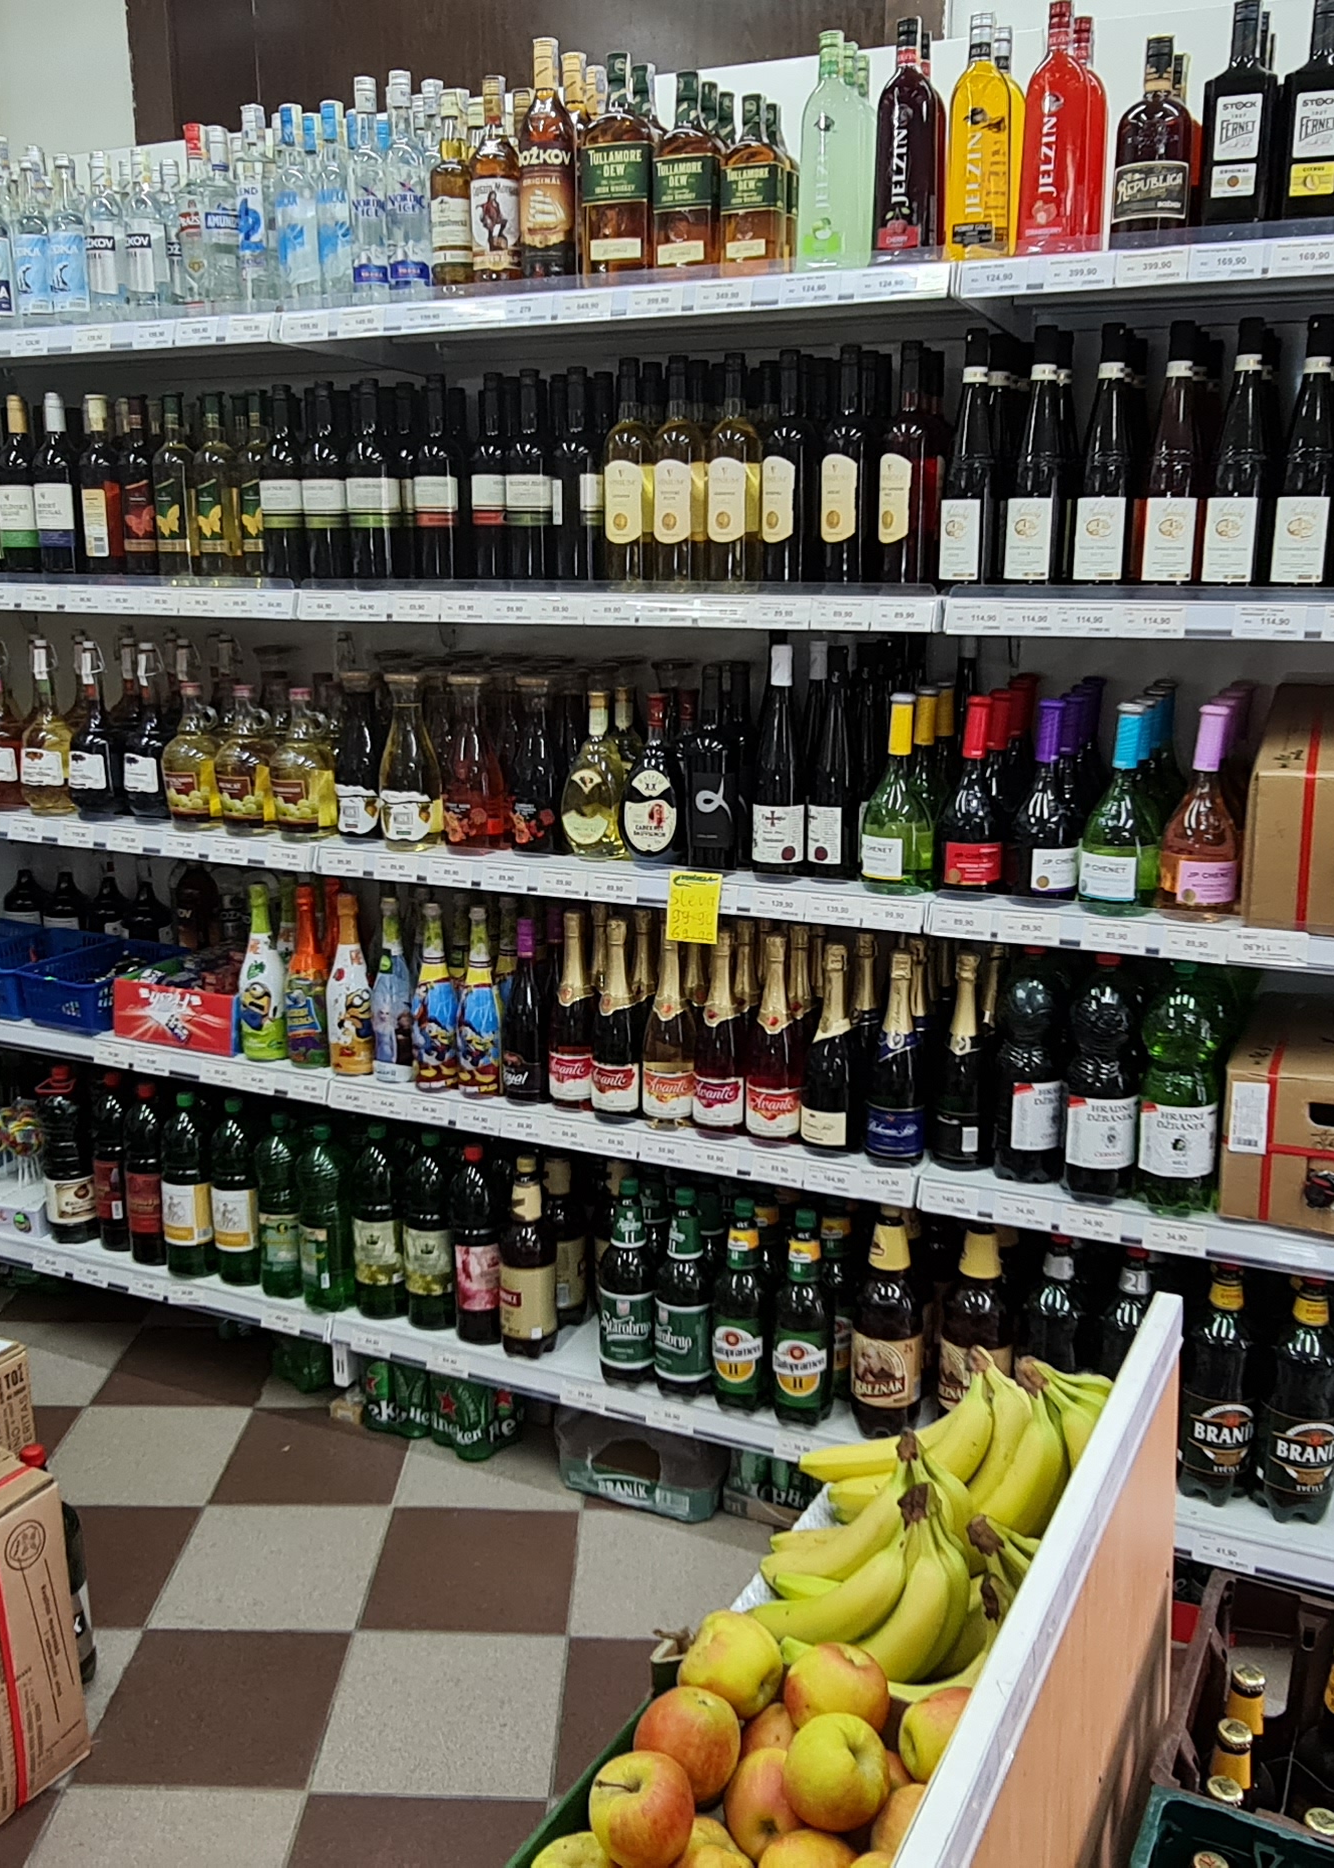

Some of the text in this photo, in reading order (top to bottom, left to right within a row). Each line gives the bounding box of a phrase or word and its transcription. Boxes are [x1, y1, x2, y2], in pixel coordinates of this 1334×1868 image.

[1222, 100, 1258, 110] STOCK
[1220, 119, 1255, 145] FERNET
[587, 149, 642, 165] TULLAMORE
[1038, 116, 1058, 197] JELZIN
[656, 160, 703, 178] TULLAMORE
[890, 127, 910, 206] JELZIN
[965, 131, 984, 214] JELZIN
[1116, 171, 1184, 203] REPUBLICA
[1216, 256, 1247, 266] 169,90
[1298, 251, 1331, 261] 169,90
[1142, 261, 1172, 271] 399,90
[985, 273, 1014, 282] 124,90
[503, 1069, 528, 1087] oyal
[597, 1479, 648, 1499] BRANÍK
